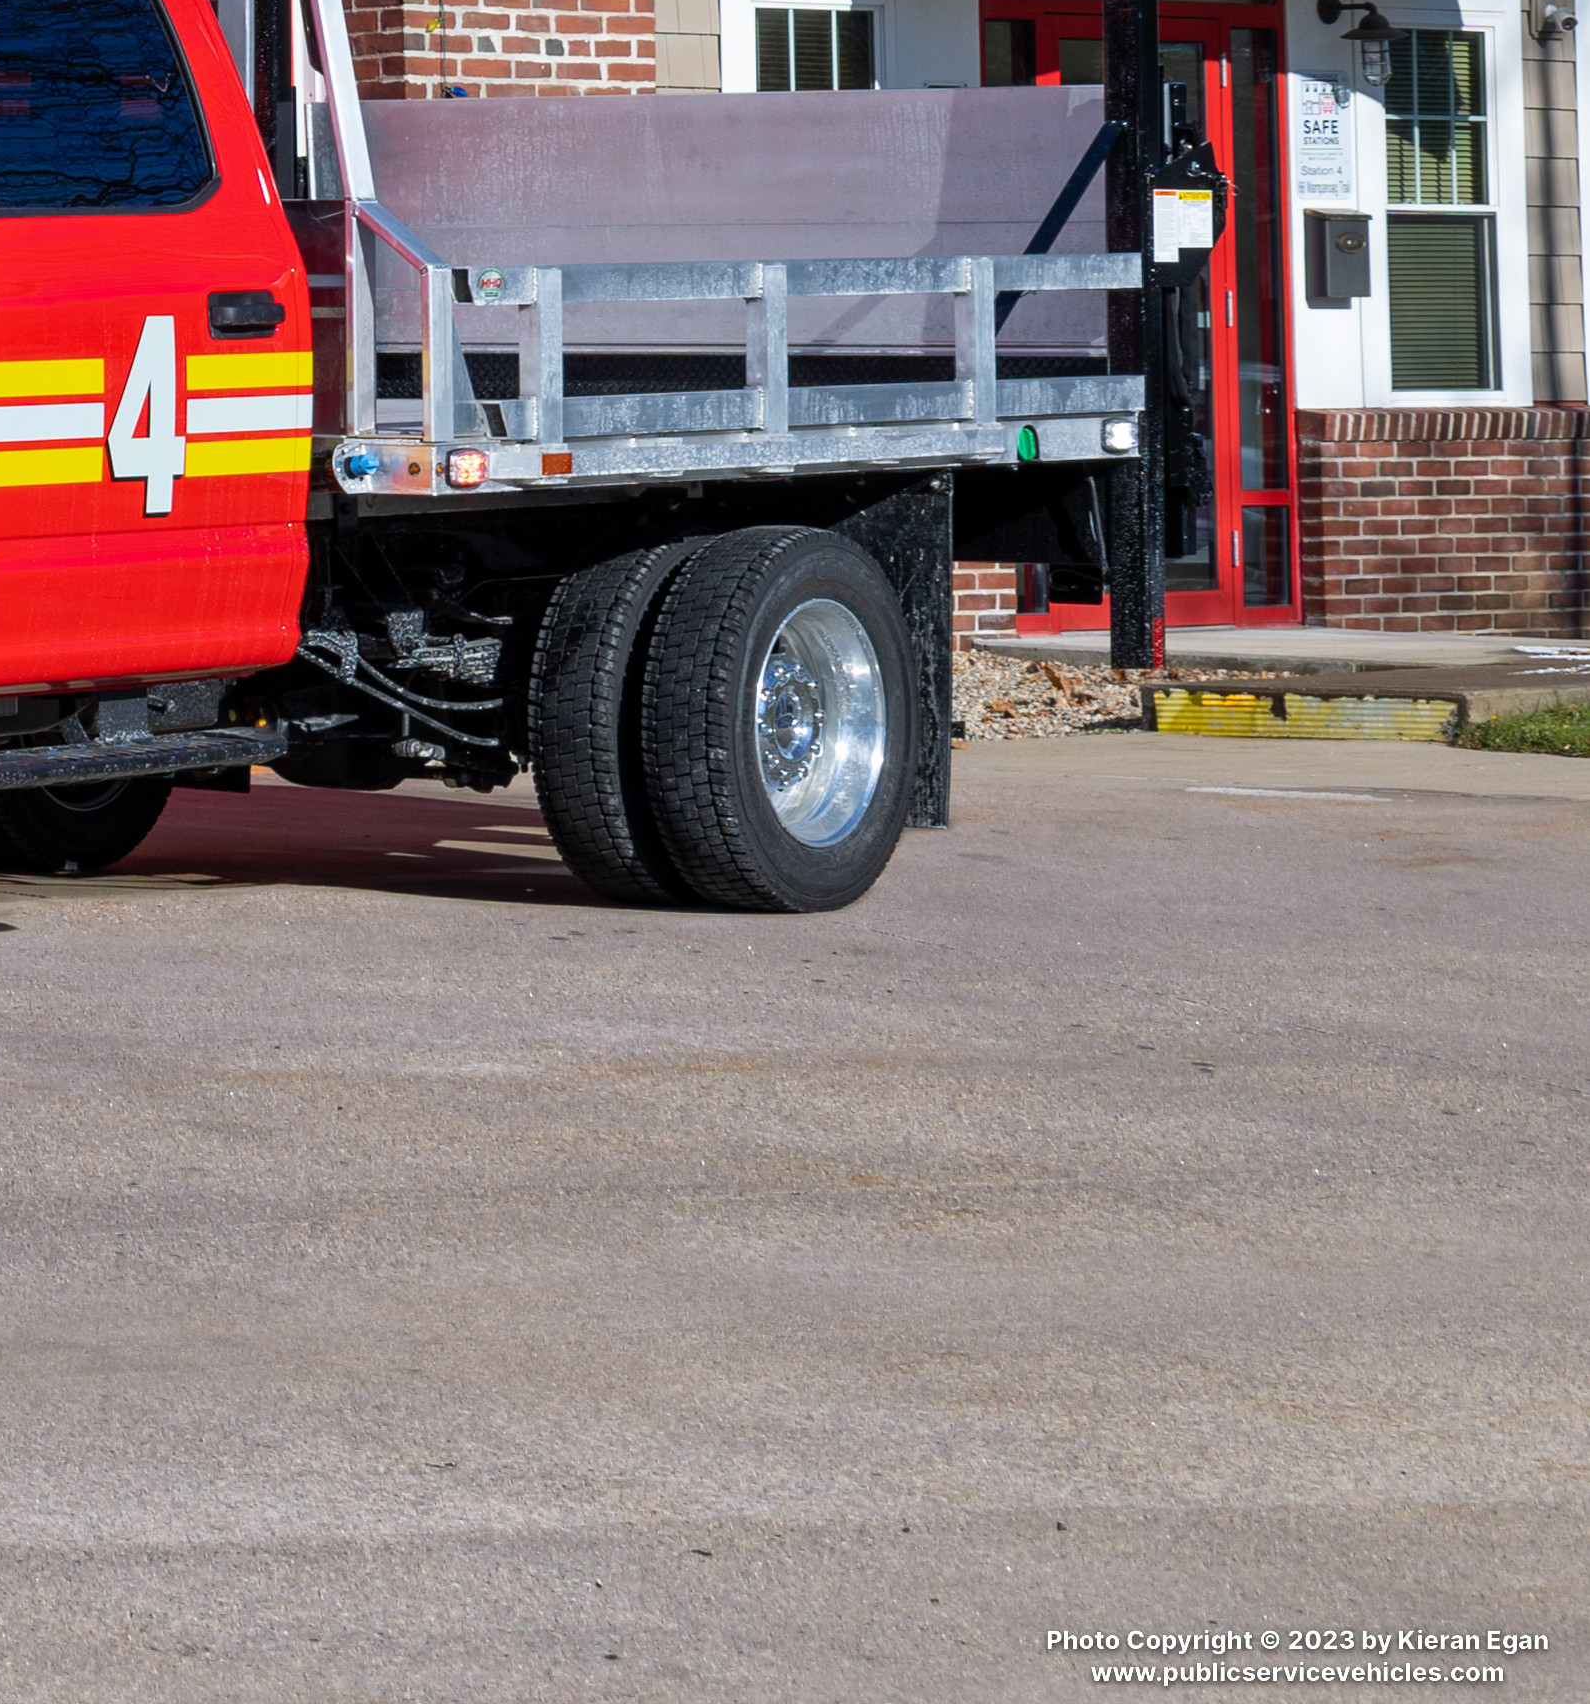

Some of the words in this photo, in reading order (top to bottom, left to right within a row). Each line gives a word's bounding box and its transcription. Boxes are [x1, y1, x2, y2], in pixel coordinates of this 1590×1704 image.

[1303, 120, 1339, 134] SAFE
[1303, 137, 1340, 145] STATIONS
[1300, 165, 1334, 176] Station
[1336, 166, 1343, 175] 4
[480, 278, 502, 289] MHQ
[107, 314, 187, 516] 4
